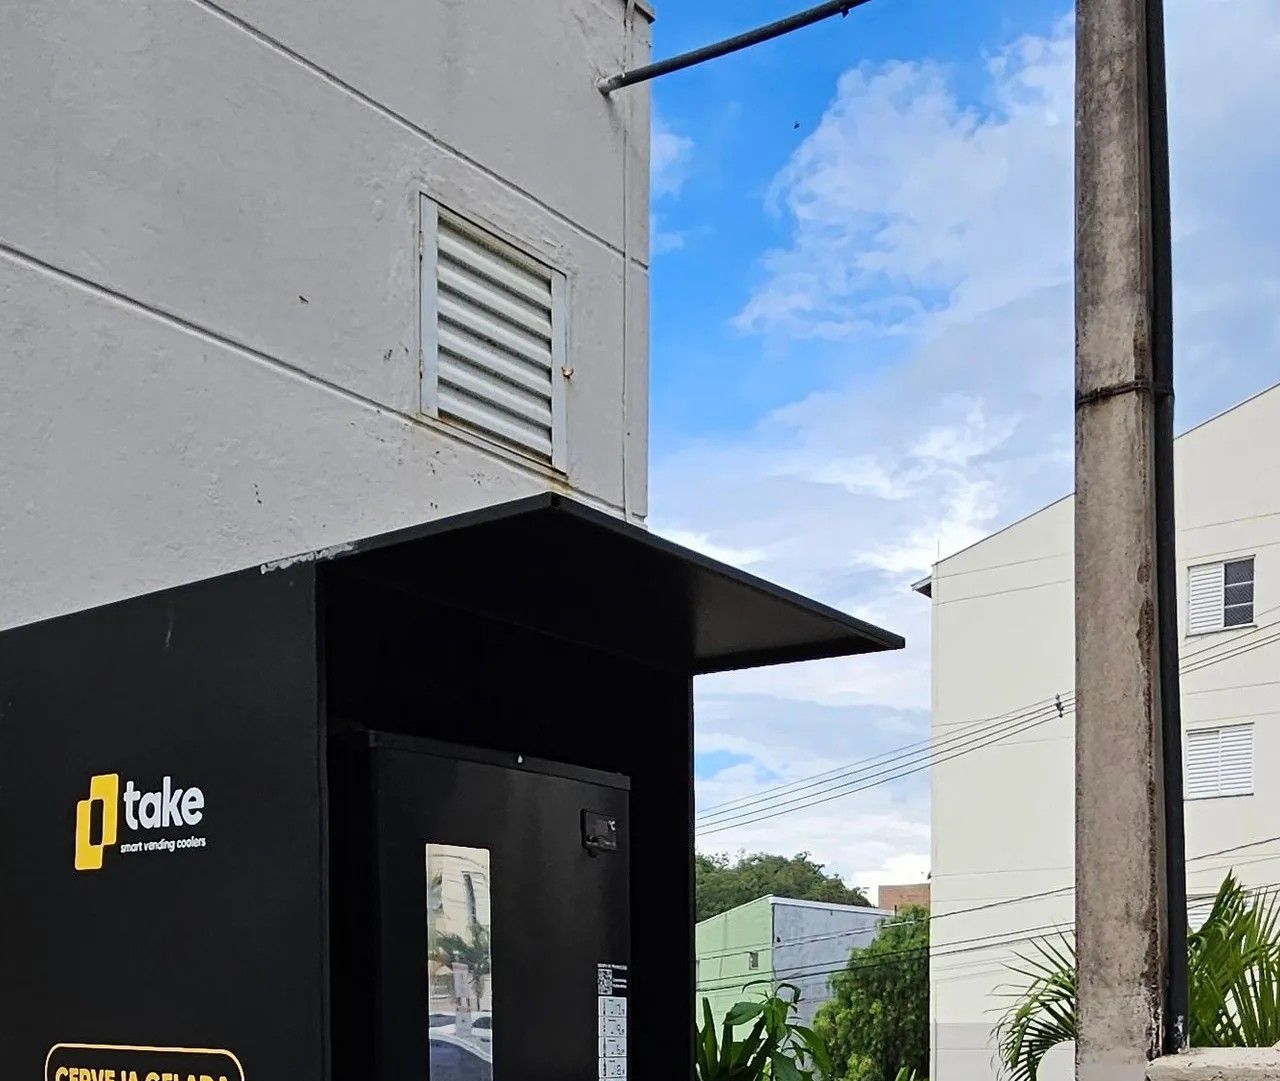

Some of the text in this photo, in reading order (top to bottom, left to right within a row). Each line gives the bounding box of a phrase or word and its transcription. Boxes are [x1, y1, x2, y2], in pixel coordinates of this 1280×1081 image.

[123, 776, 205, 830] take
[120, 836, 206, 853] smart vending coolers
